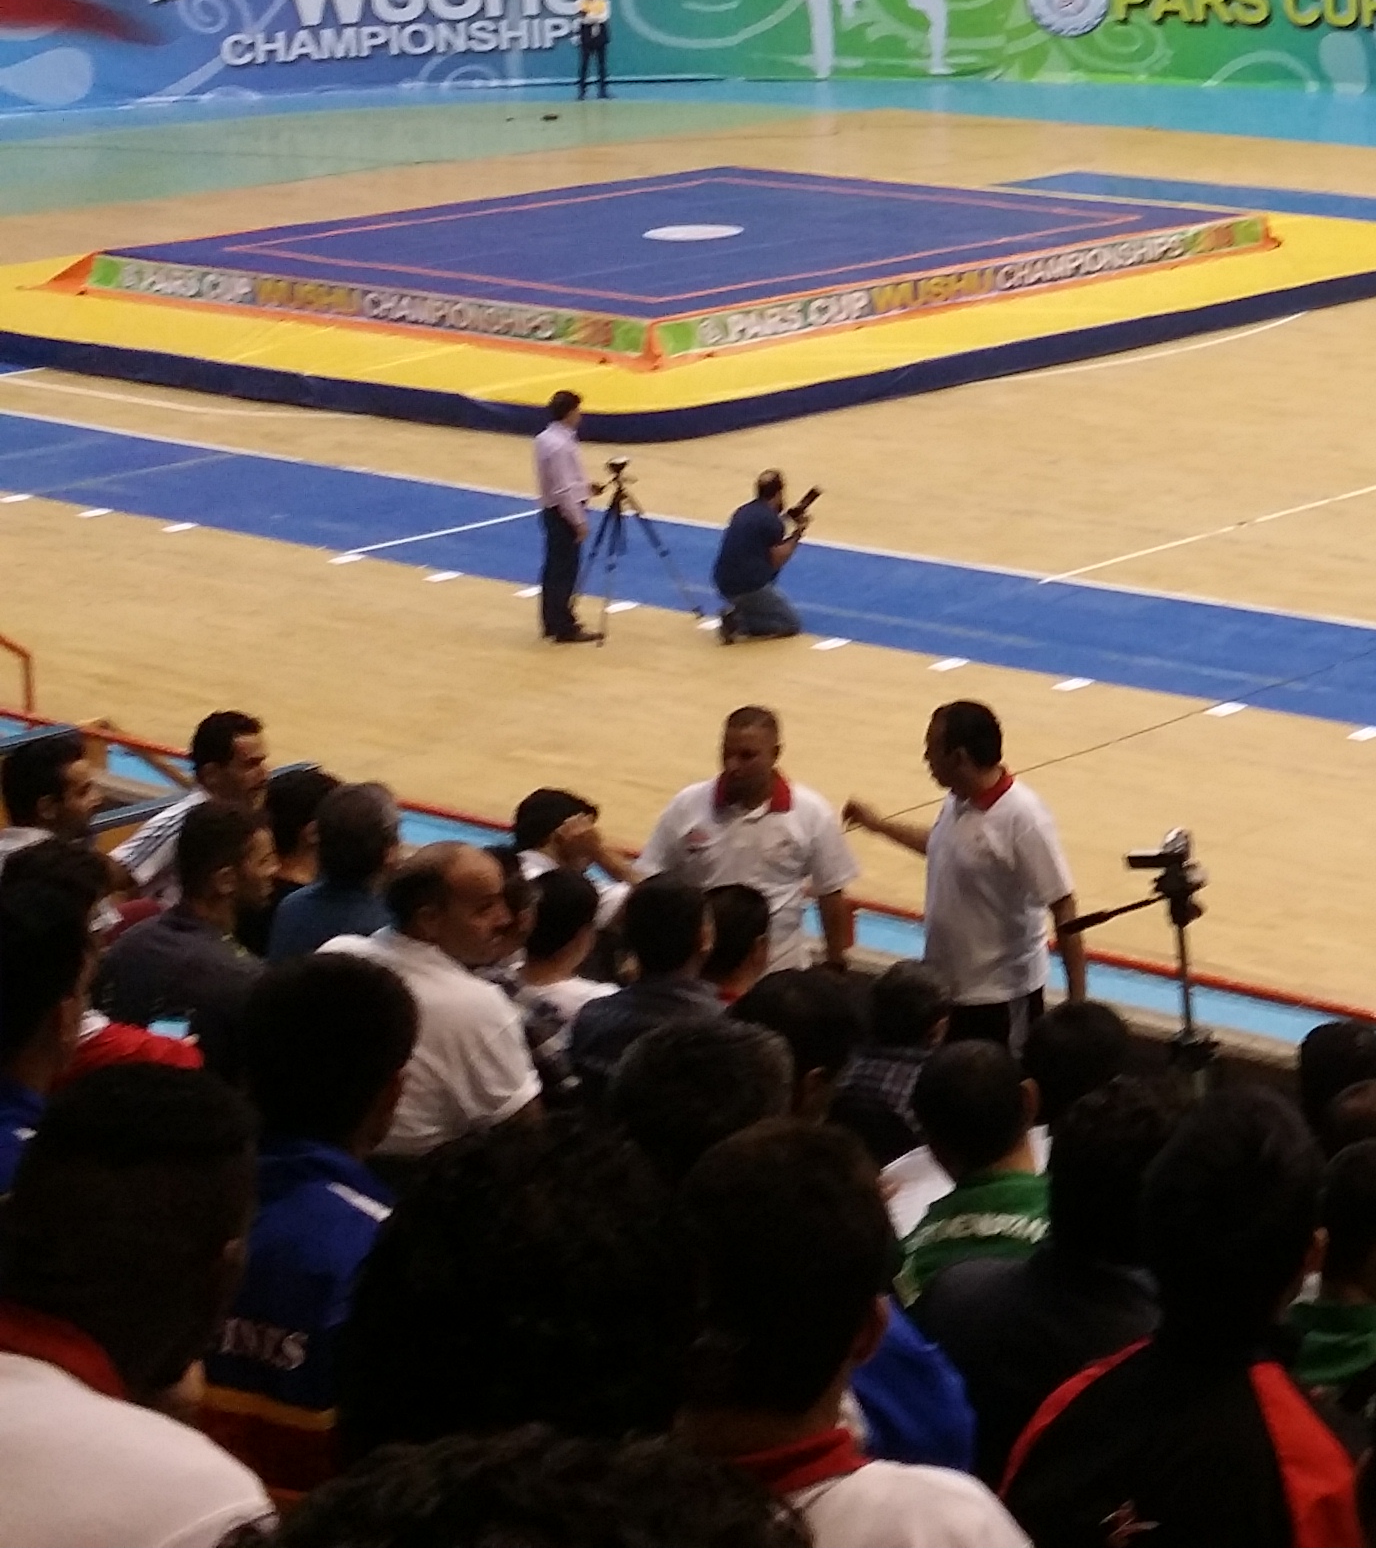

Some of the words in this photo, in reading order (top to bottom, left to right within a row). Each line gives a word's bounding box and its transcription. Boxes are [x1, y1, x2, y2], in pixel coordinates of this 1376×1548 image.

[807, 290, 871, 326] CUP
[871, 267, 996, 313] WUSHU
[997, 234, 1185, 292] CHAMPIONSHIPS
